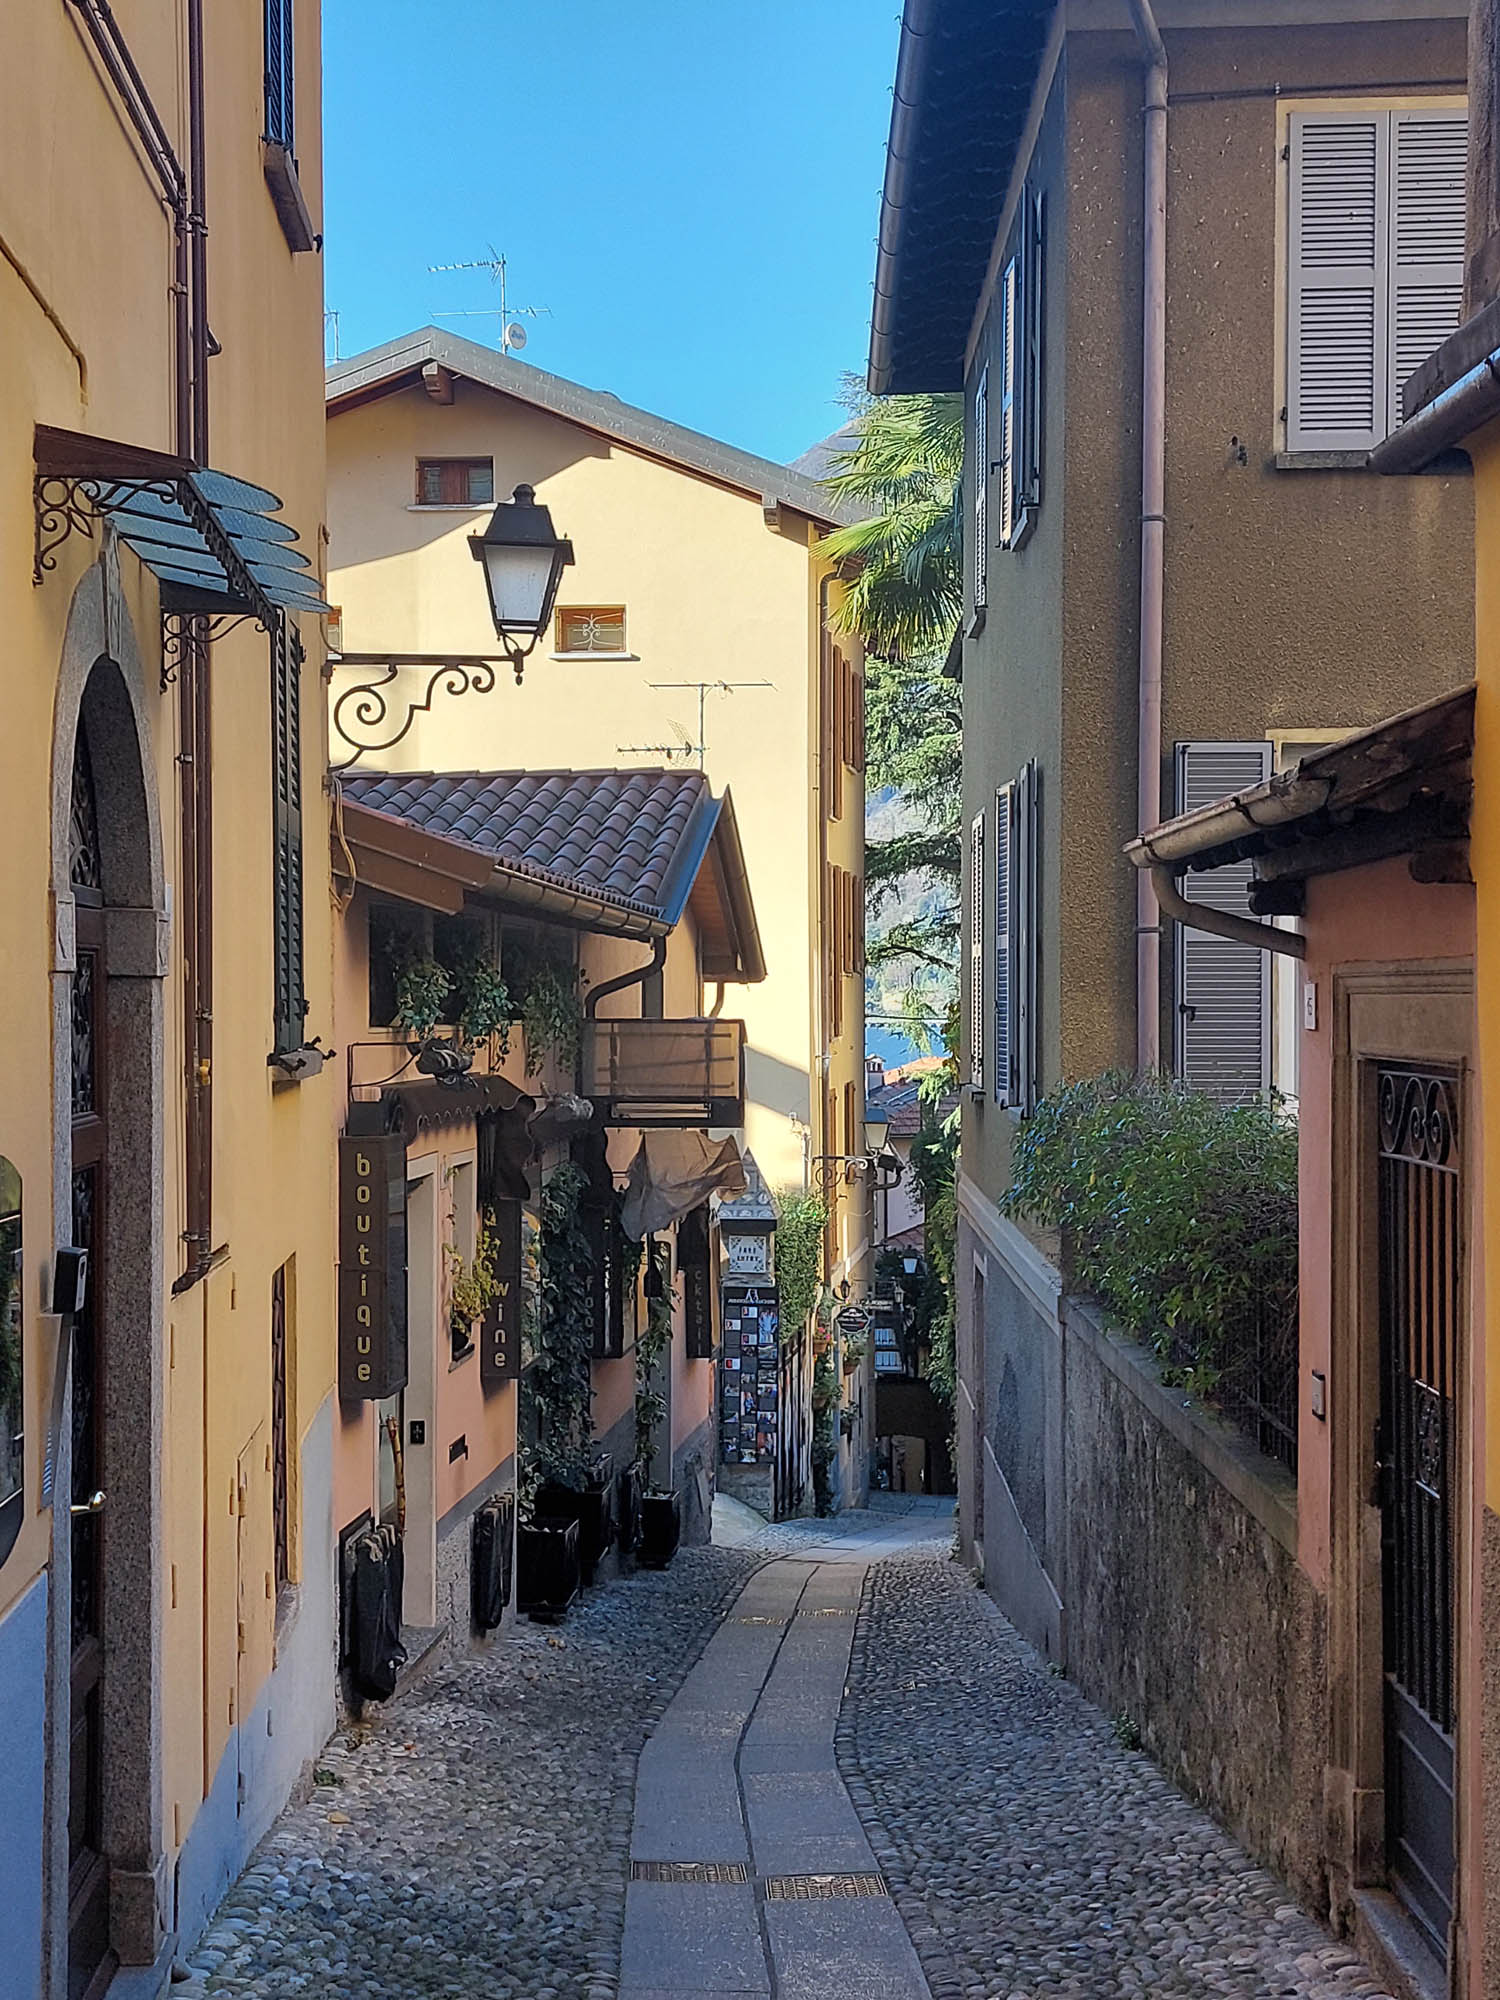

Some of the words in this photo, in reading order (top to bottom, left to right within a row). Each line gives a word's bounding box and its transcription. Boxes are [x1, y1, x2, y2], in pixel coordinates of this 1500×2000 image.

[356, 1152, 371, 1382] boutique
[492, 1279, 510, 1367] wine
[694, 1270, 703, 1356] cktail
